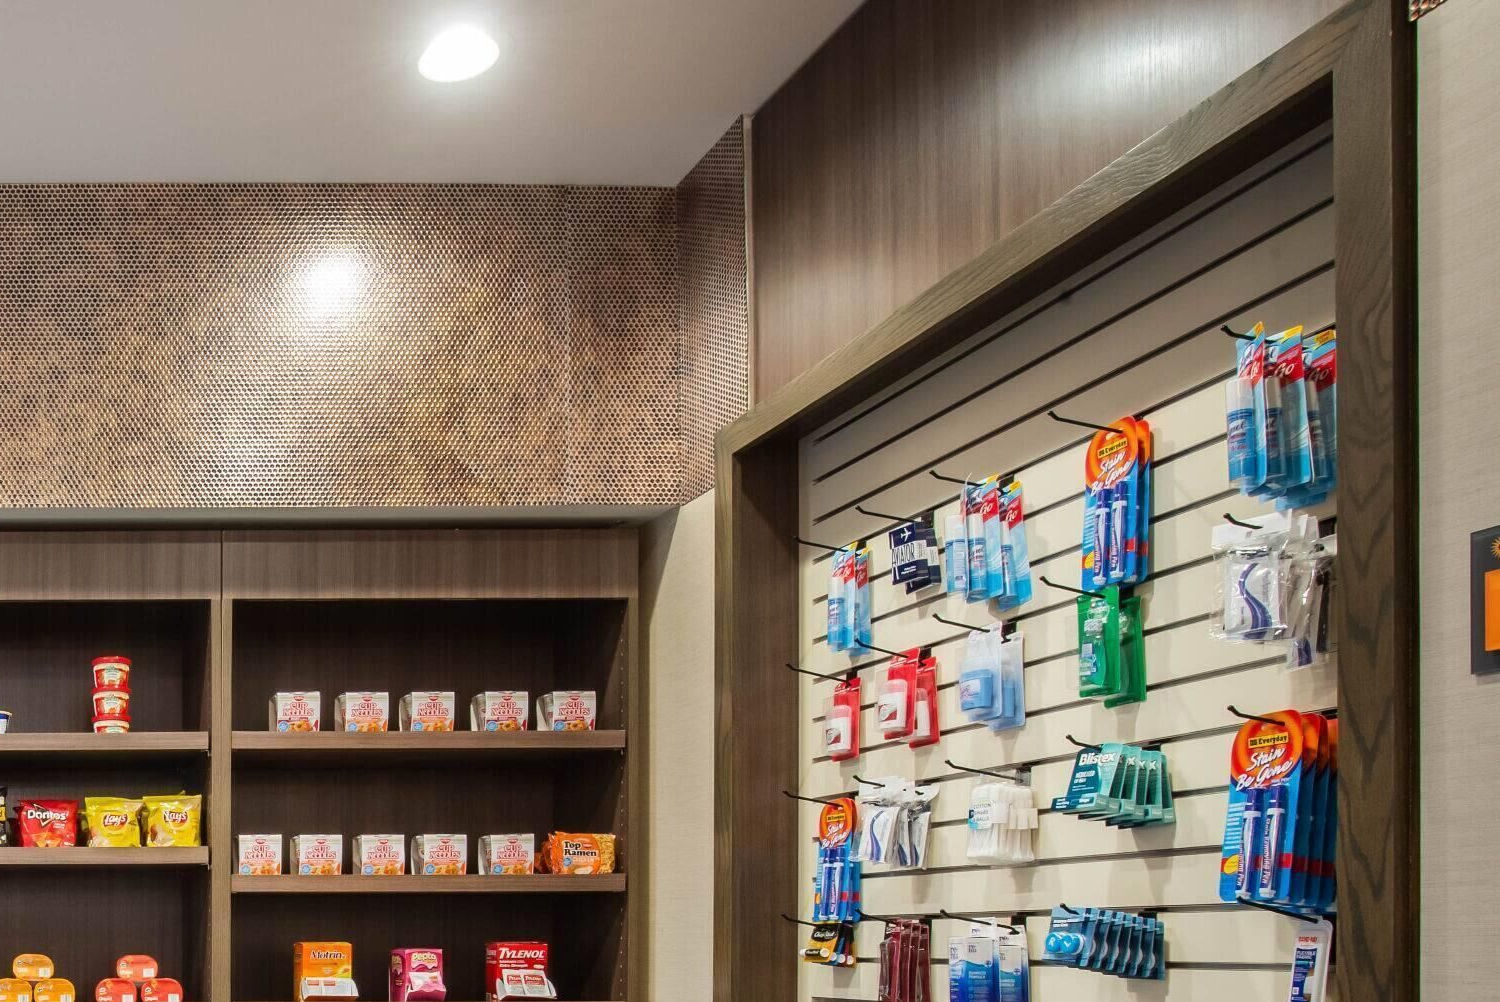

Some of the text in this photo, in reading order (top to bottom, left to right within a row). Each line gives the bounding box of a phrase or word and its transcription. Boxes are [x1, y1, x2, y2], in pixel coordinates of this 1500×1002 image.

[1258, 734, 1288, 746] Everyday
[1078, 752, 1116, 766] Blistex
[1246, 747, 1286, 772] Stain
[1236, 774, 1254, 791] Be
[564, 841, 581, 850] Top
[564, 849, 597, 857] Ramen
[499, 947, 545, 959] TYLENOL
